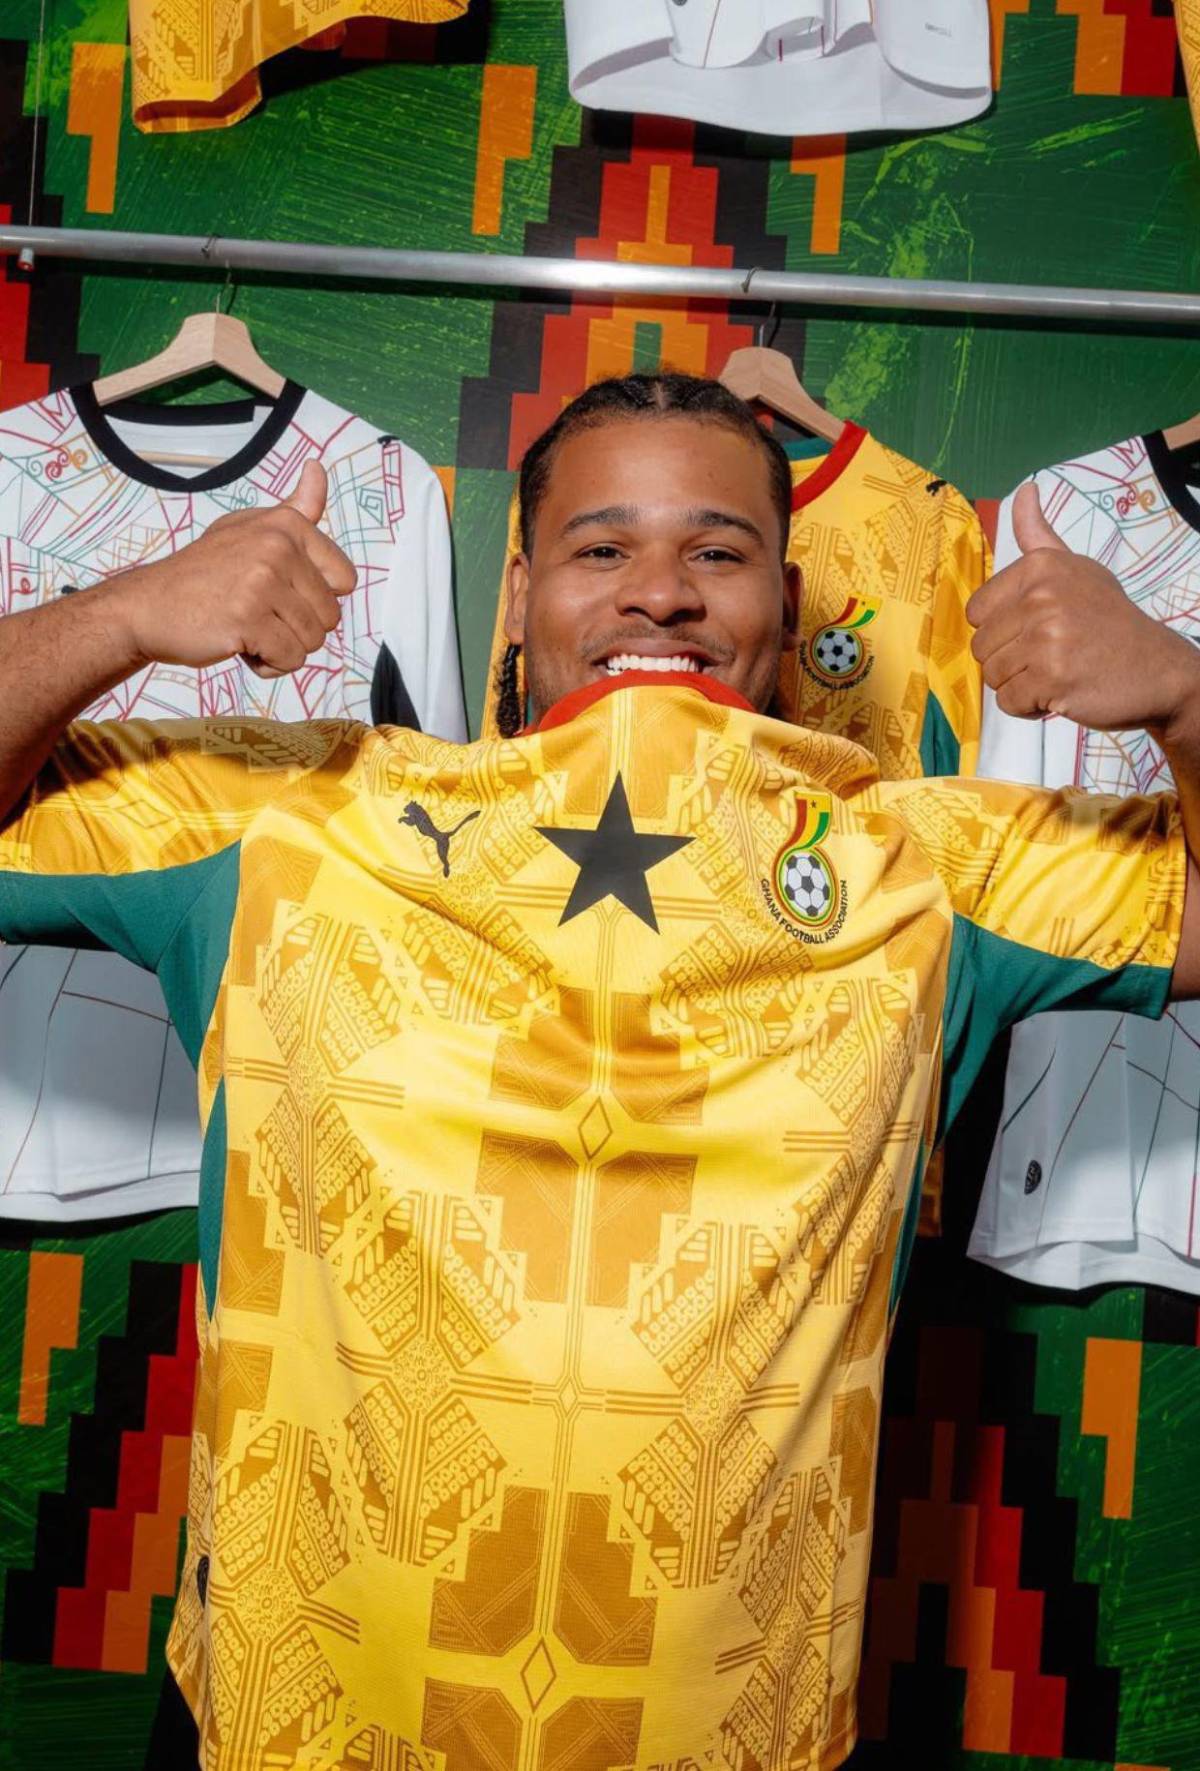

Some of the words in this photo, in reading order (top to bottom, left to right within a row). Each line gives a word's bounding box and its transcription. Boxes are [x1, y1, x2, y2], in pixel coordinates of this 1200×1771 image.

[761, 879, 782, 921] GHANA
[779, 918, 824, 944] FOOTBALL
[825, 880, 848, 942] ASSOCIATION
